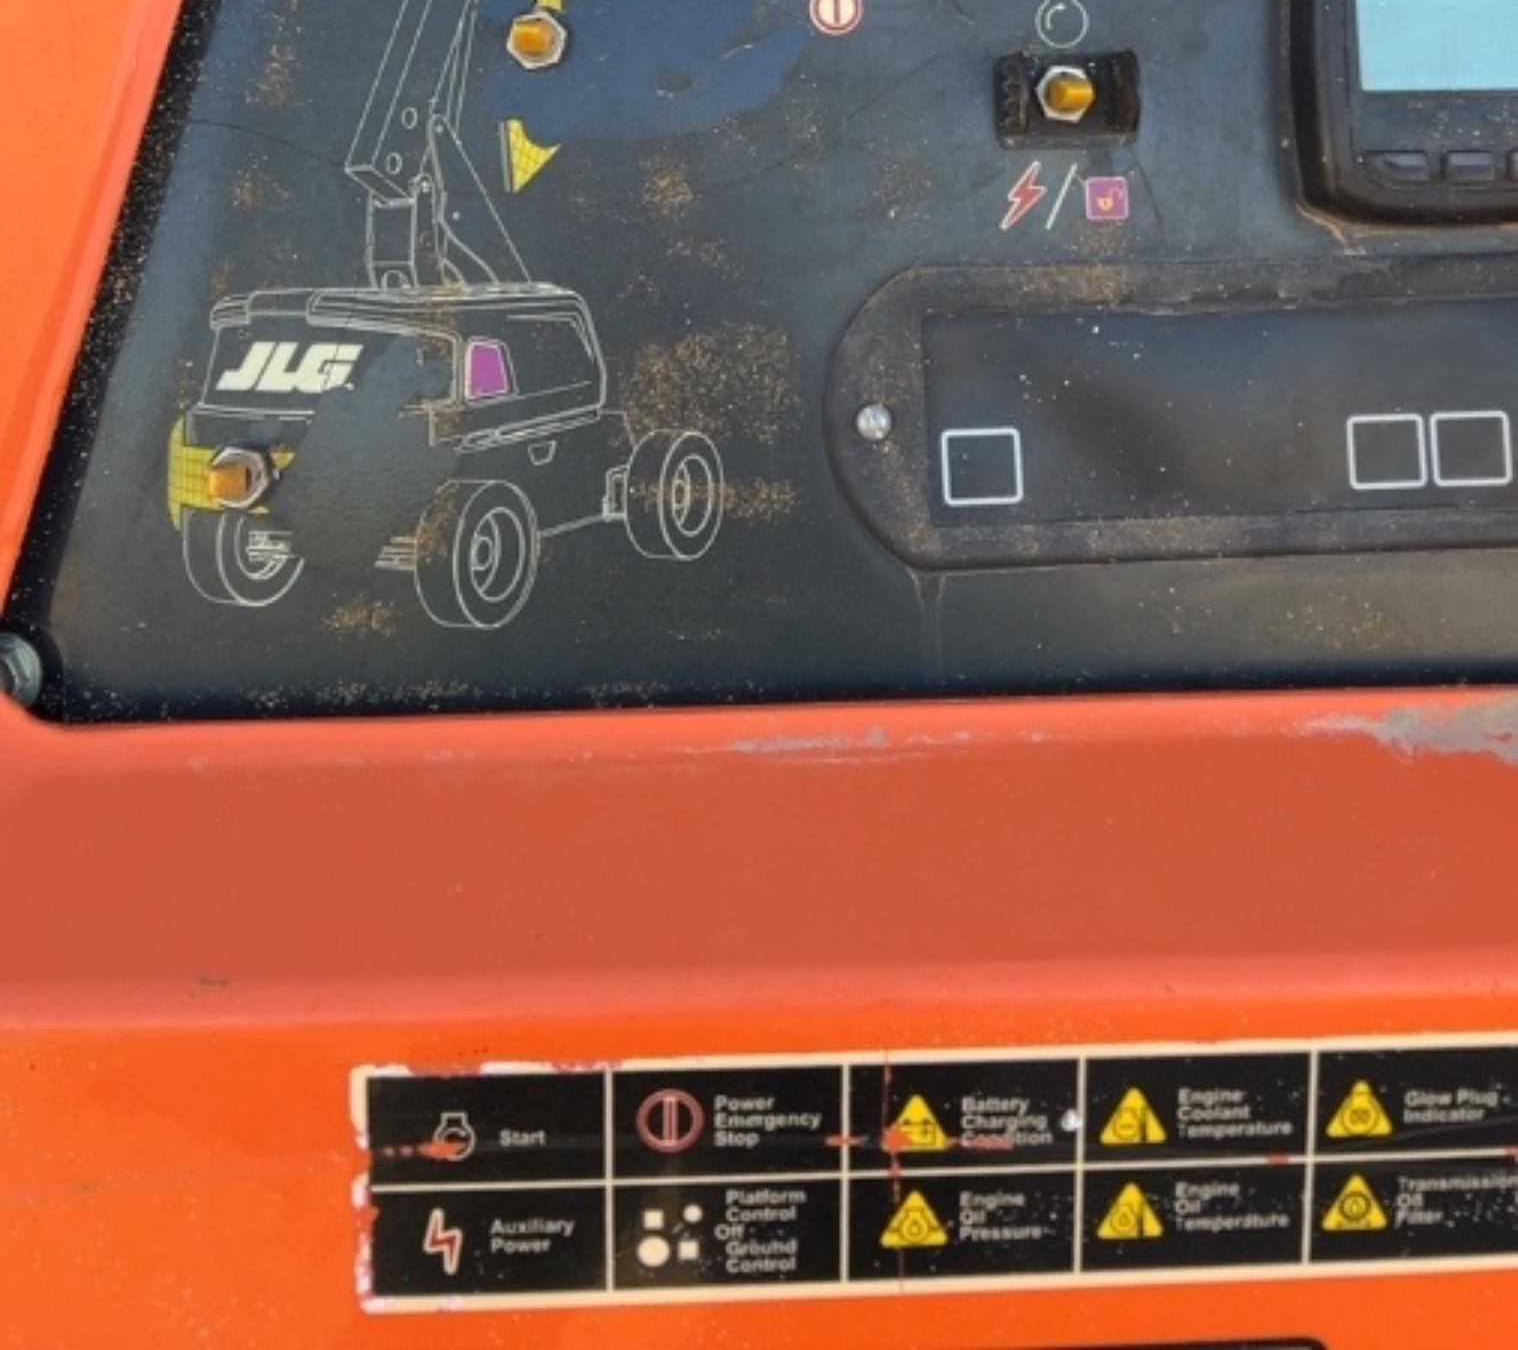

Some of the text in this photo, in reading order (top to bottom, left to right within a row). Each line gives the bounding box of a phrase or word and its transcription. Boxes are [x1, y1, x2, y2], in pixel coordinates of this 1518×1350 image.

[215, 341, 363, 393] JLG
[714, 1095, 775, 1112] Power
[1178, 1088, 1245, 1107] Engine
[1403, 1088, 1499, 1107] Glow Plug
[961, 1096, 1030, 1117] Battery
[1178, 1106, 1250, 1120] Coolant
[714, 1111, 823, 1130] Emergency
[962, 1114, 1048, 1131] Charging
[1403, 1108, 1484, 1123] Indicator
[499, 1128, 547, 1147] Start
[714, 1130, 760, 1148] Stop
[1178, 1121, 1293, 1140] Temperature
[725, 1189, 806, 1204] Platform
[1175, 1182, 1240, 1200] Engine
[959, 1191, 1024, 1209] Engine
[1175, 1200, 1201, 1214] Oil
[1397, 1192, 1423, 1208] Oil
[725, 1206, 796, 1221] Control
[959, 1208, 987, 1224] Oil
[1395, 1209, 1443, 1229] Filter
[489, 1217, 574, 1237] Auxiliary
[714, 1223, 744, 1239] Off
[1175, 1214, 1290, 1233] Temperature
[959, 1225, 1042, 1241] Pressure
[491, 1237, 550, 1254] Power
[725, 1239, 797, 1255] Ground
[725, 1256, 796, 1273] Control
